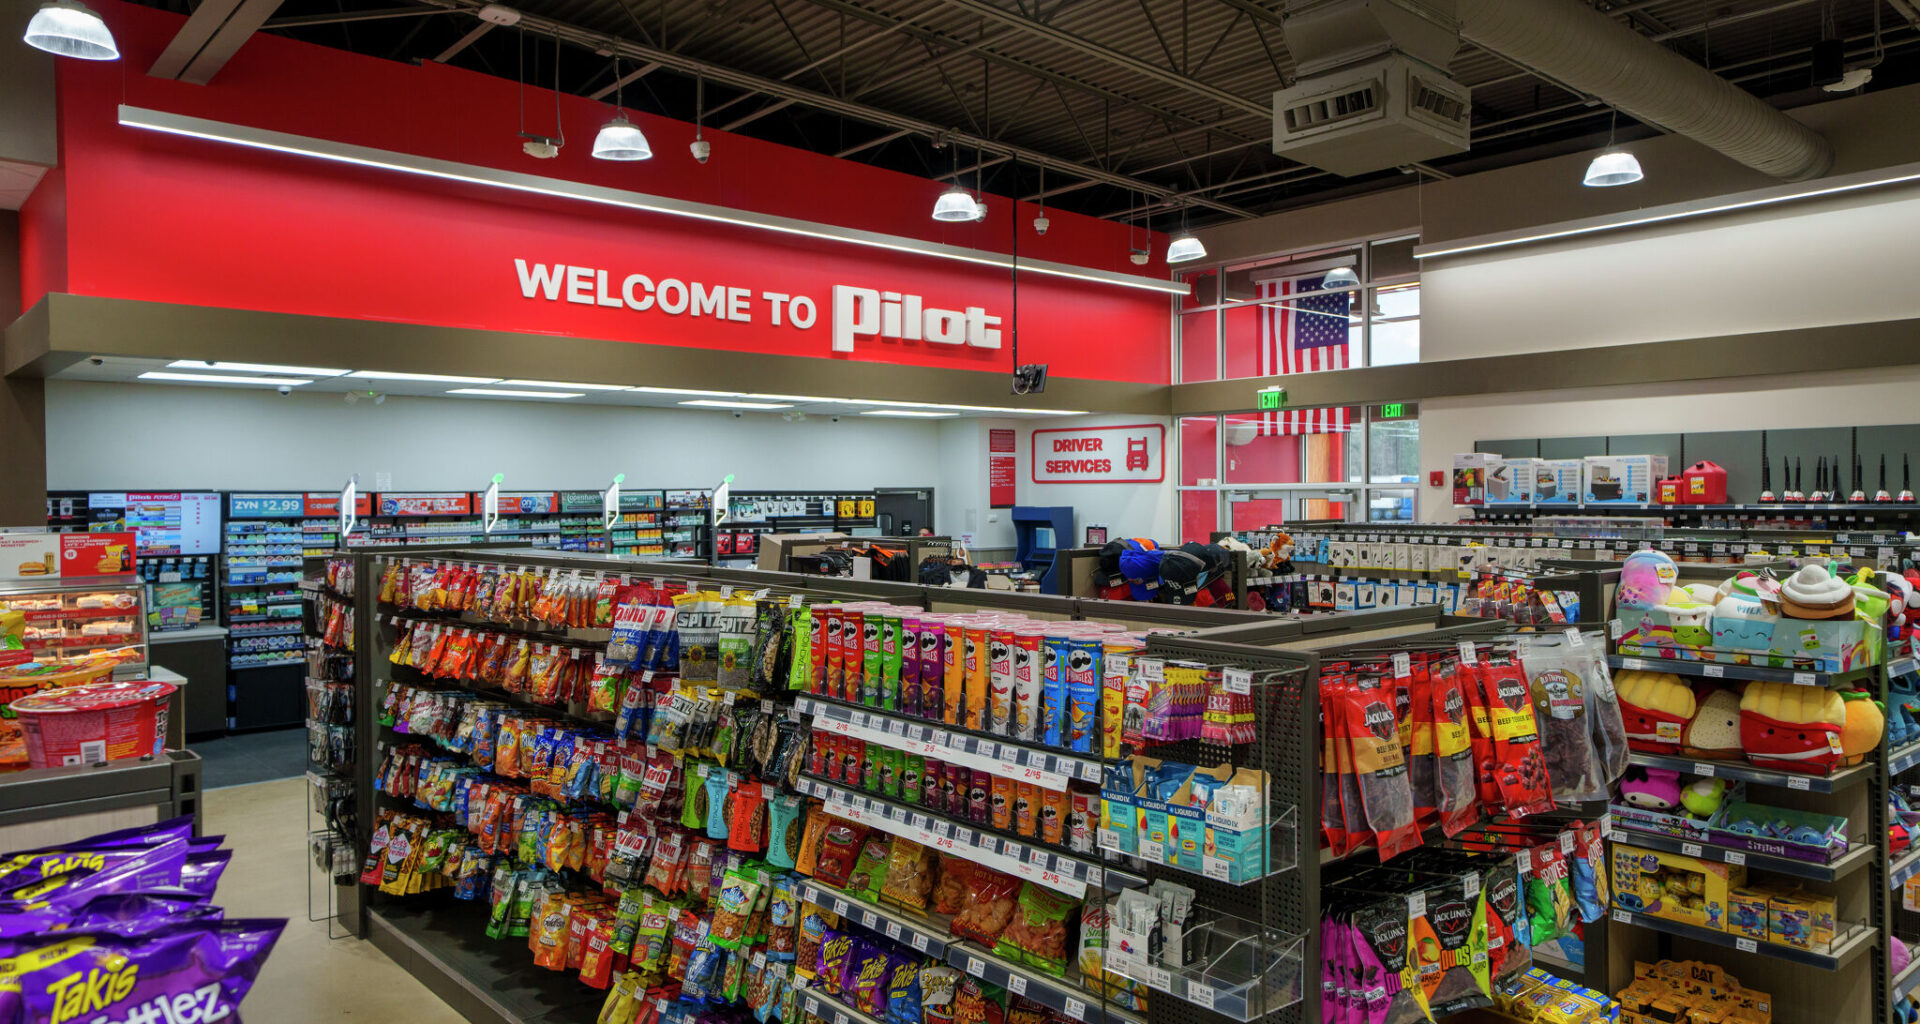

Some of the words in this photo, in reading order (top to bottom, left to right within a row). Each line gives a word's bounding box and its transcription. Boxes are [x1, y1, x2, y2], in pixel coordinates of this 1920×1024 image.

[514, 258, 751, 323] WELCOME
[762, 291, 817, 329] TO
[832, 284, 1002, 352] Pilot
[1262, 392, 1280, 408] EXIT
[1385, 404, 1402, 417] EXIT
[1053, 438, 1103, 453] DRIVER
[1045, 459, 1112, 473] SERVICES
[234, 500, 259, 510] ZYN
[263, 500, 300, 511] $2.99
[615, 607, 646, 623] DAVID
[1736, 604, 1763, 616] MILK
[677, 612, 721, 628] SPITZ
[720, 616, 757, 634] SPITZ
[1207, 695, 1231, 709] B12
[620, 756, 643, 775] DAVID
[1024, 768, 1041, 780] 2/$5
[1106, 792, 1124, 802] LIQUID
[1143, 800, 1160, 811] LIQUID
[1174, 806, 1191, 817] LIQUID
[1212, 815, 1229, 826] LIQUID
[936, 837, 953, 849] 2/$5
[1042, 871, 1059, 884] 2/$5
[620, 898, 640, 915] BIGS
[641, 914, 667, 929] BIGS
[1434, 912, 1451, 923] JACK
[1450, 907, 1472, 920] LINK'S
[1374, 932, 1389, 945] JACK
[823, 938, 852, 965] Takis
[1441, 944, 1471, 971] DUOS
[859, 956, 890, 983] Takis
[891, 964, 918, 989] Takis
[1691, 966, 1714, 983] CAT
[1420, 972, 1441, 983] MANGO
[46, 964, 139, 1024] Takis
[89, 981, 230, 1024] attlez
